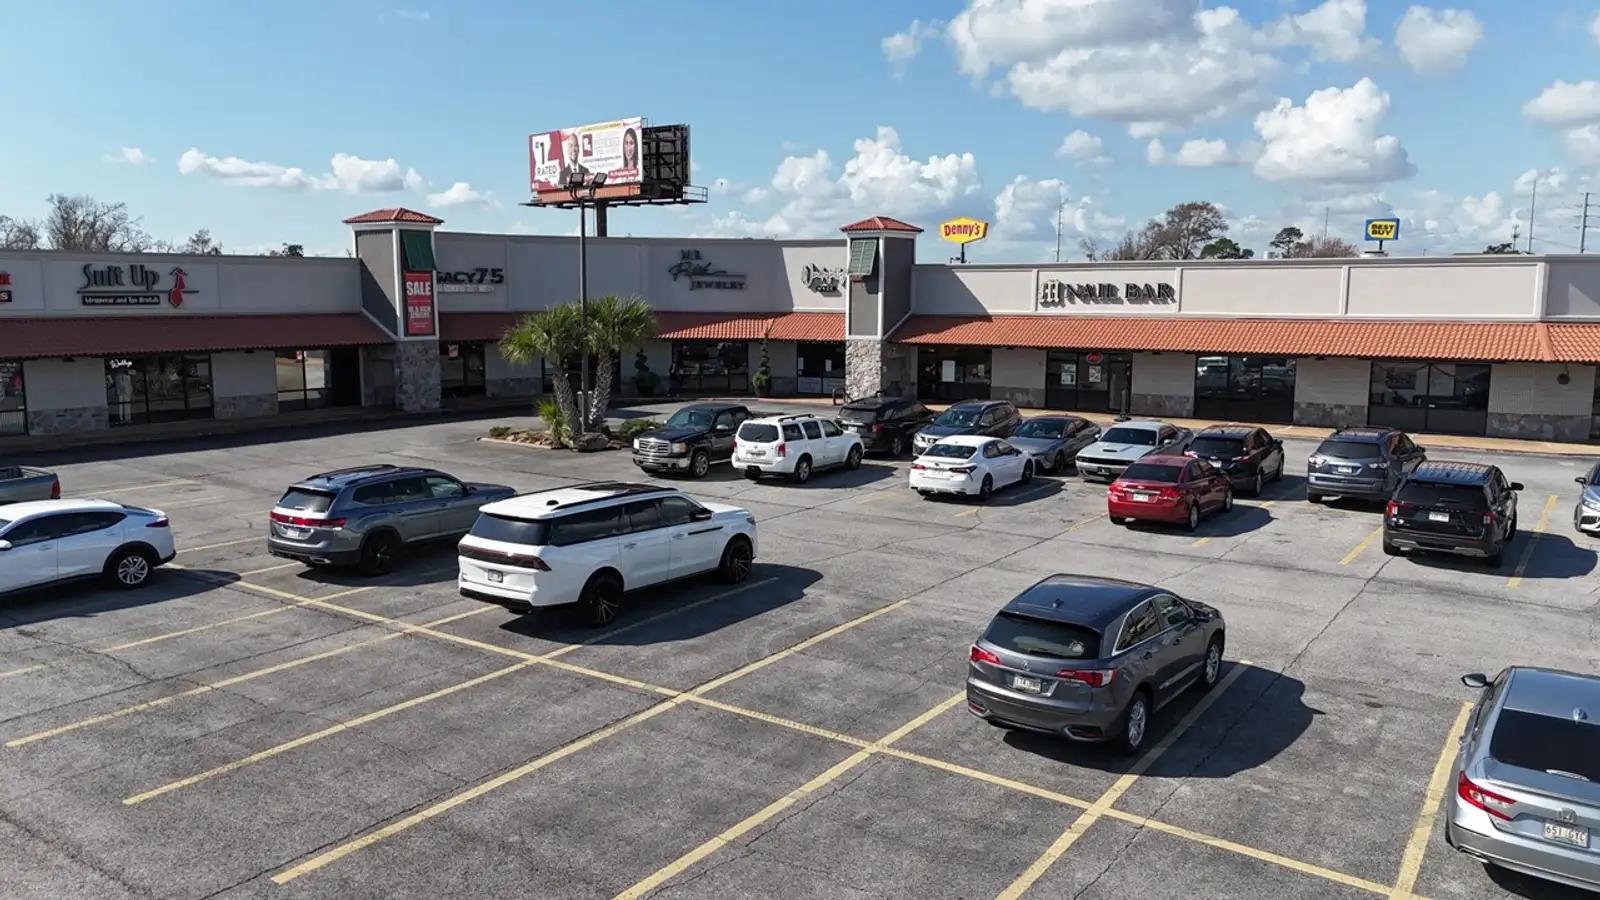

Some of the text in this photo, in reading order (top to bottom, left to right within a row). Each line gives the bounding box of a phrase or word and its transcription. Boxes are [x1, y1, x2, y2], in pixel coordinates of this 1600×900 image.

[537, 165, 557, 176] RATED
[944, 222, 981, 237] Denny's
[80, 263, 160, 293] Suit Up
[690, 279, 747, 291] JEWELRY
[406, 281, 432, 296] SALE
[1065, 283, 1119, 299] NAIL
[1124, 283, 1173, 299] BAR
